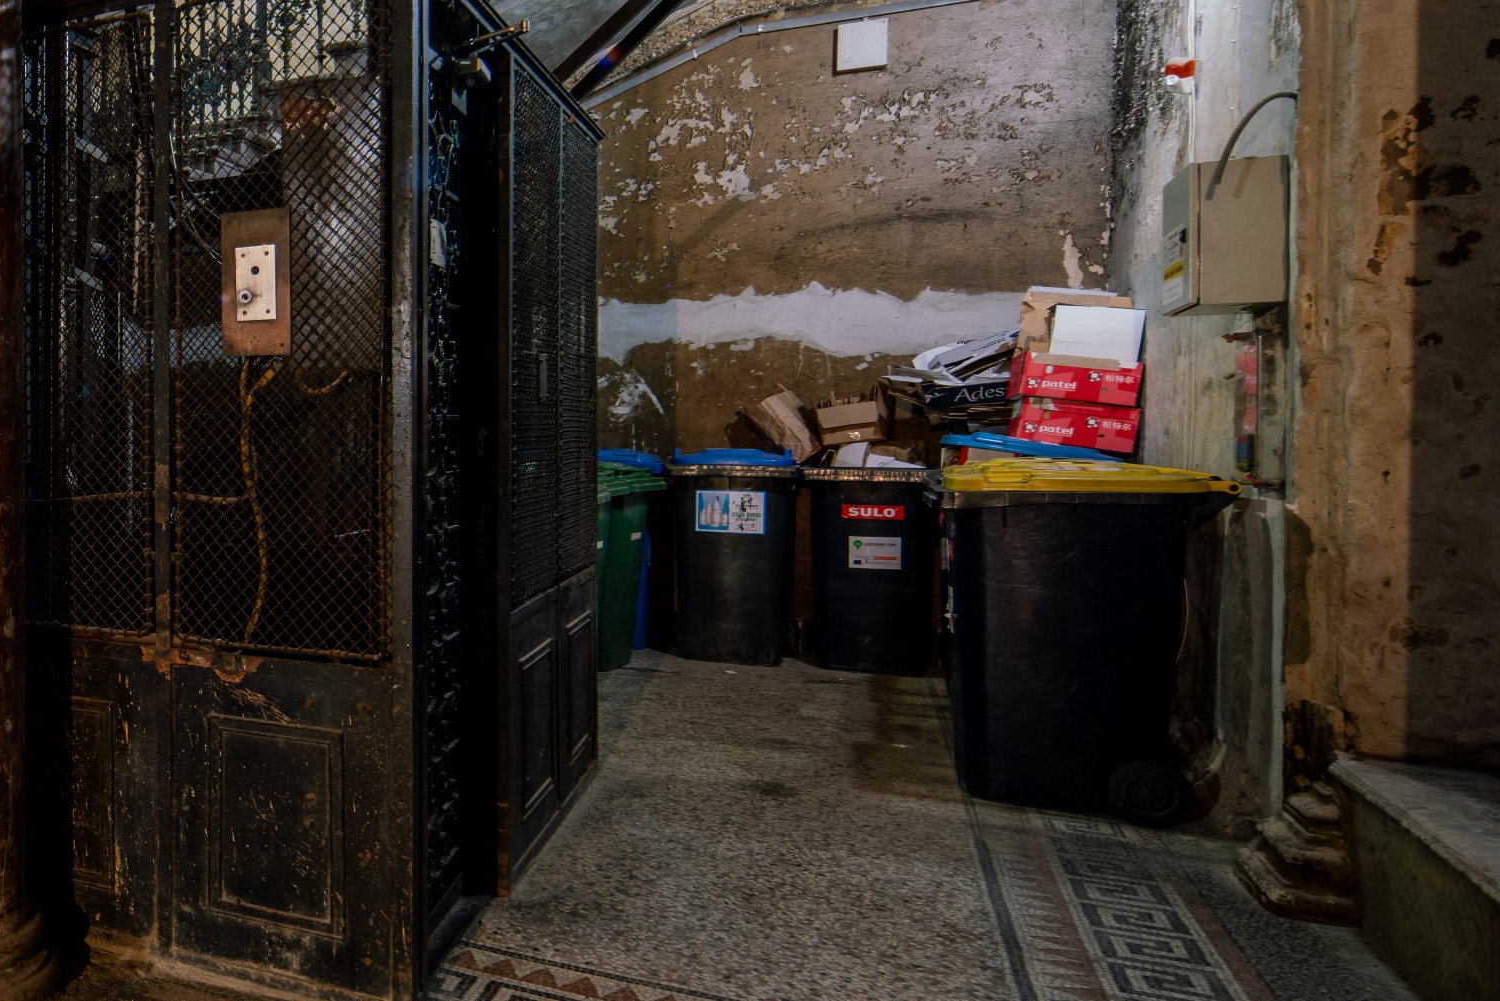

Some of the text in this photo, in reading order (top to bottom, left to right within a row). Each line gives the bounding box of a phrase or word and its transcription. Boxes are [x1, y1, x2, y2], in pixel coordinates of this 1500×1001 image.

[1041, 380, 1077, 391] patel
[954, 386, 1008, 402] Ades
[1039, 425, 1074, 436] patel
[848, 506, 896, 518] SULO
